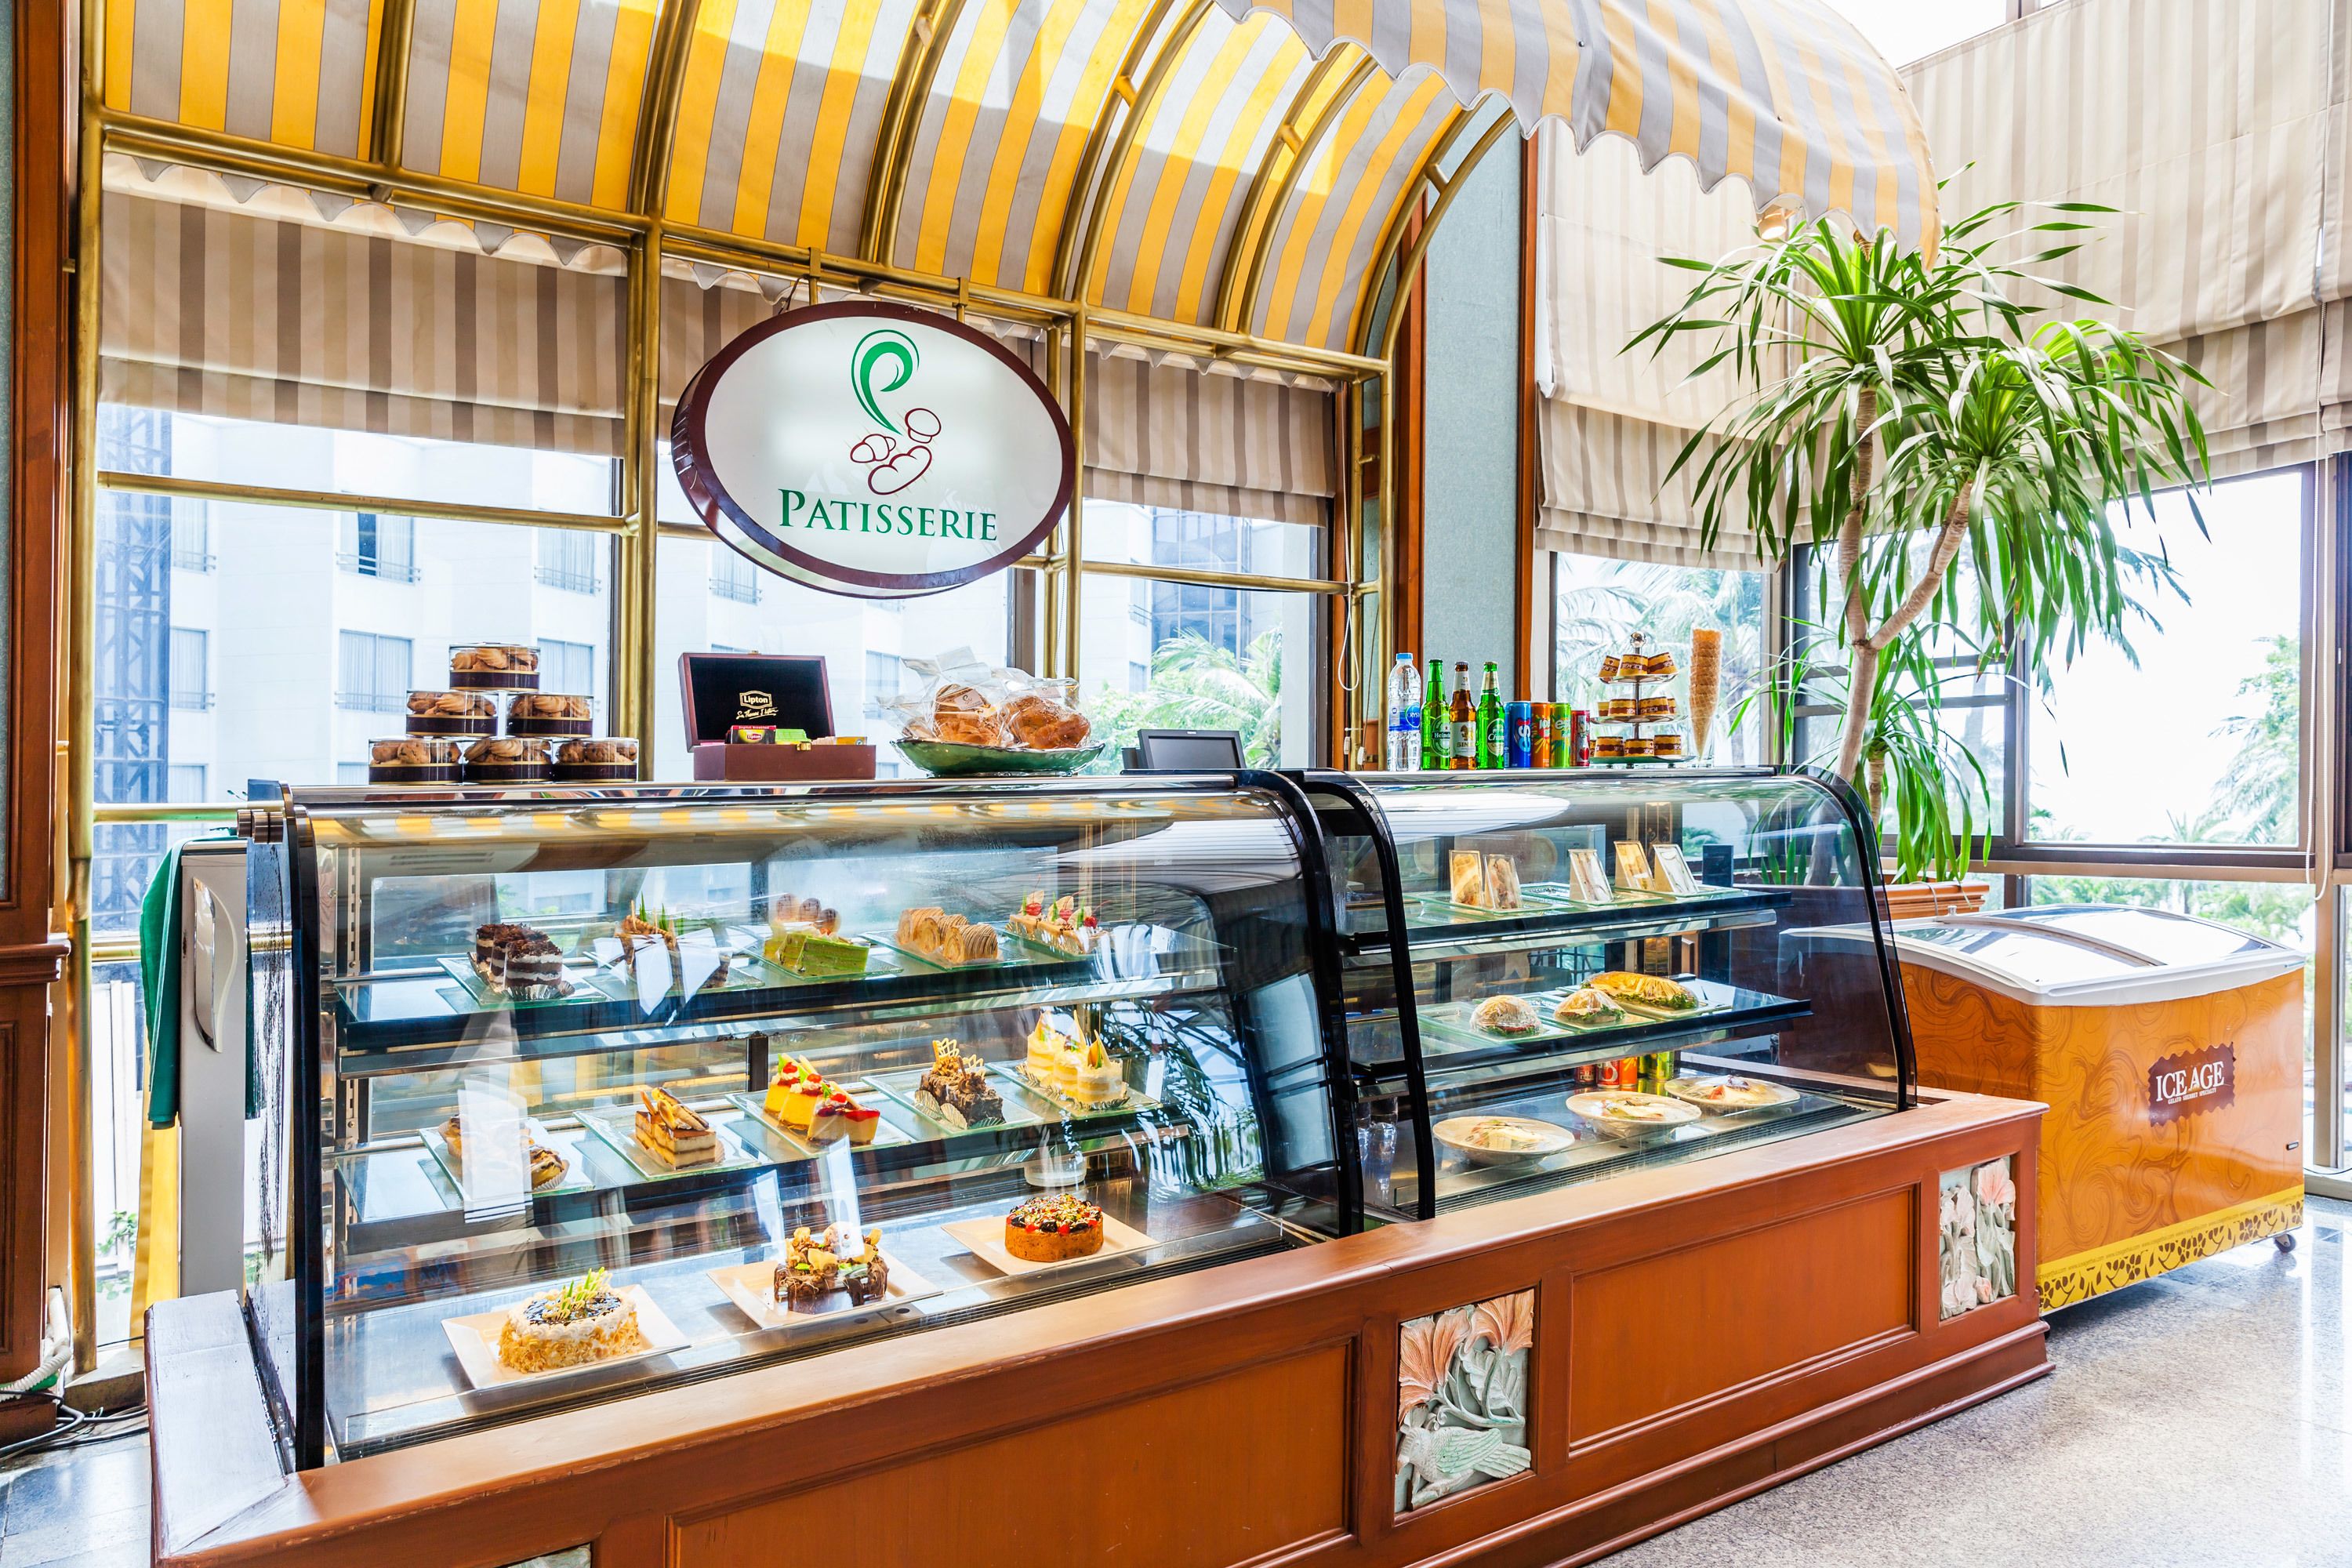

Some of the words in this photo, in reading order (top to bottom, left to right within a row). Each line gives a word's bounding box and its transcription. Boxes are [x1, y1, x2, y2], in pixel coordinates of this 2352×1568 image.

[778, 488, 997, 541] PATISSERIE
[743, 695, 768, 705] Lipton
[2156, 1070, 2187, 1102] ICE
[2188, 1061, 2224, 1091] AGE
